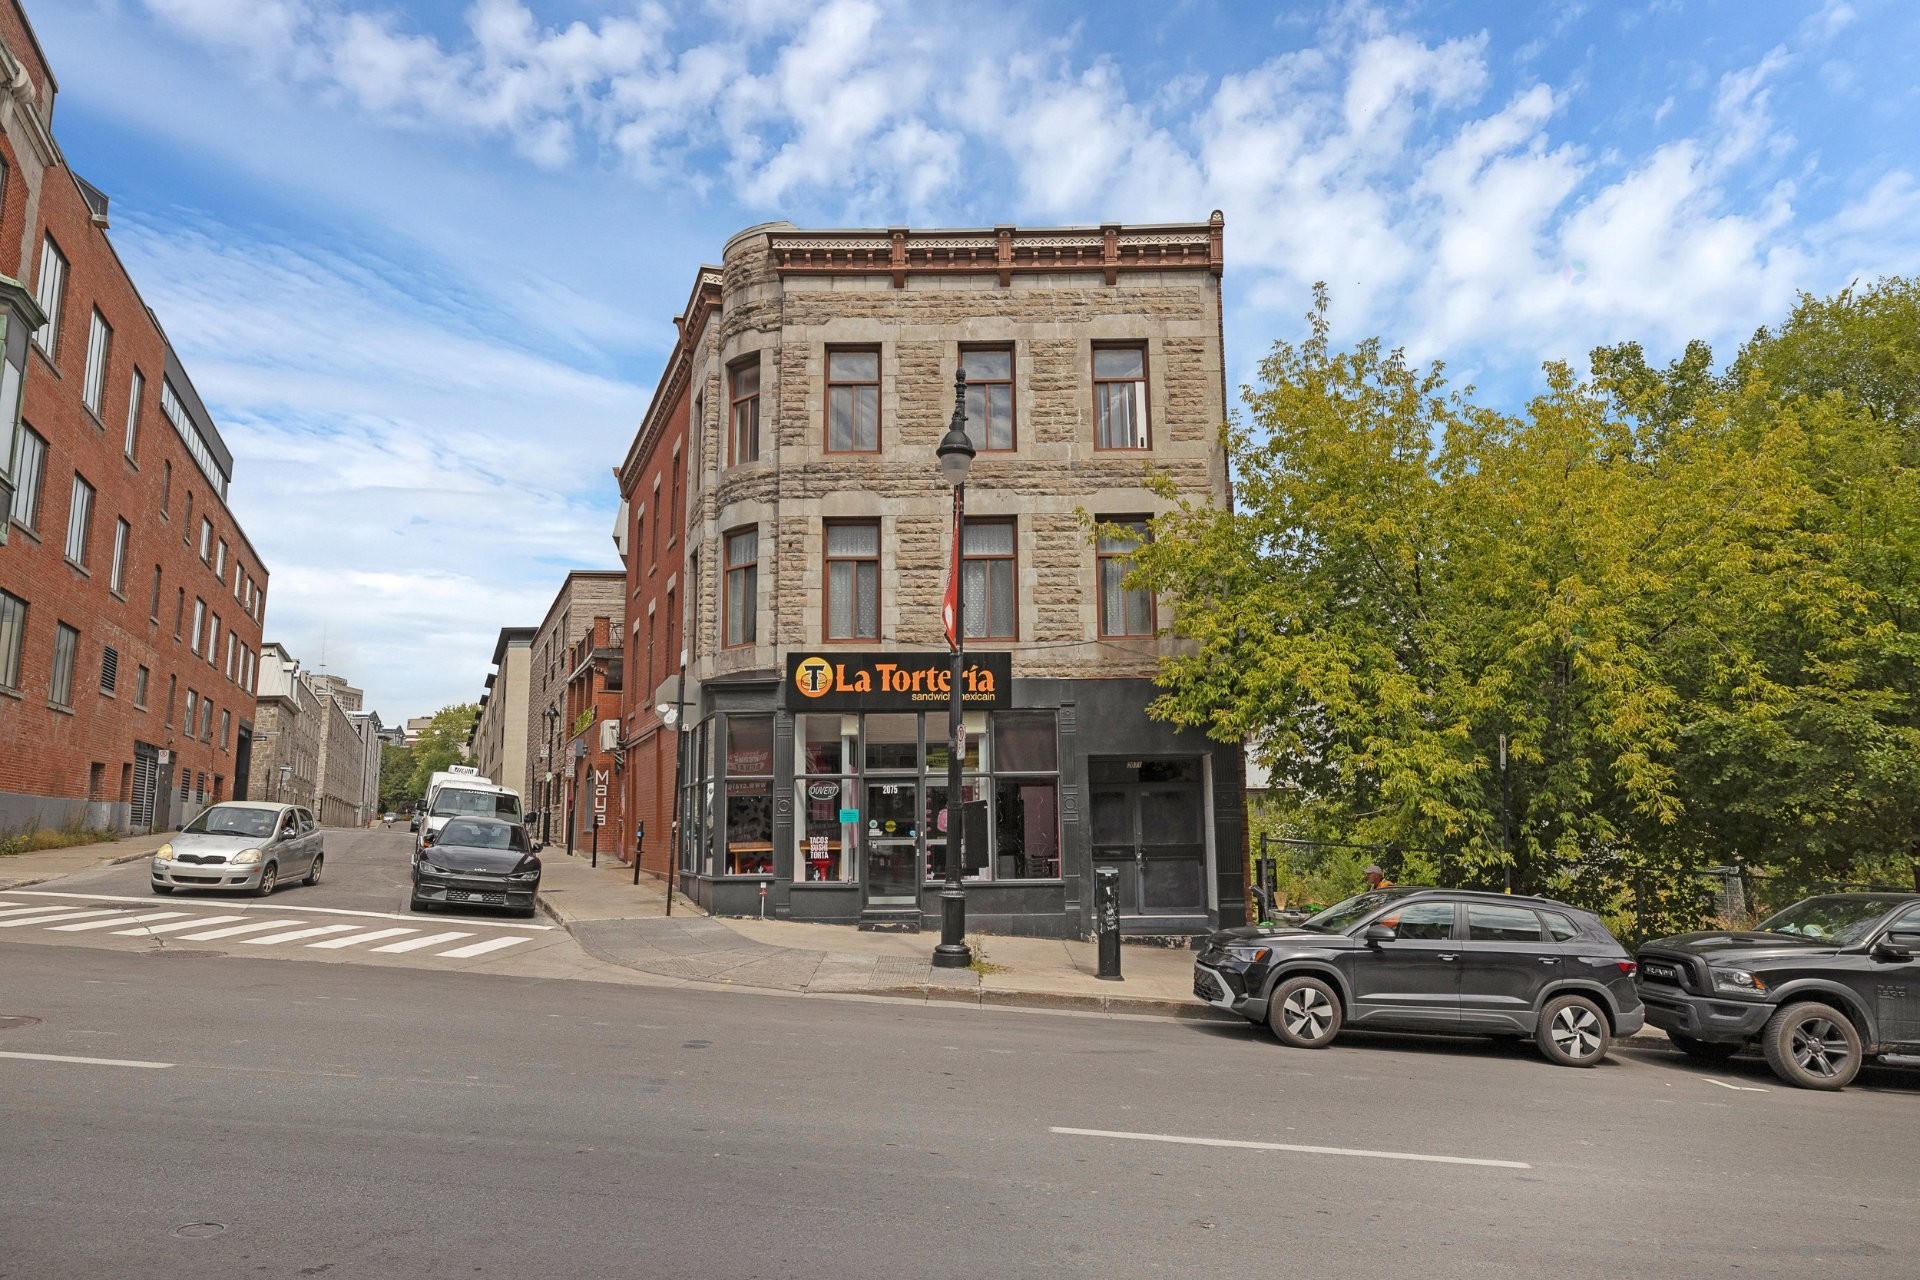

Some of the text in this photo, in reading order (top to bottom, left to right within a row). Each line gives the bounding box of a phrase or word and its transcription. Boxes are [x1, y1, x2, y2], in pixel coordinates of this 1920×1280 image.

[836, 664, 995, 692] La Torteía
[962, 692, 995, 701] exicain
[810, 785, 837, 795] OUVERT
[882, 784, 898, 795] 2075
[595, 770, 609, 826] Maya
[809, 836, 829, 844] TACOS
[809, 851, 829, 859] TORTA
[1646, 967, 1673, 977] RAM
